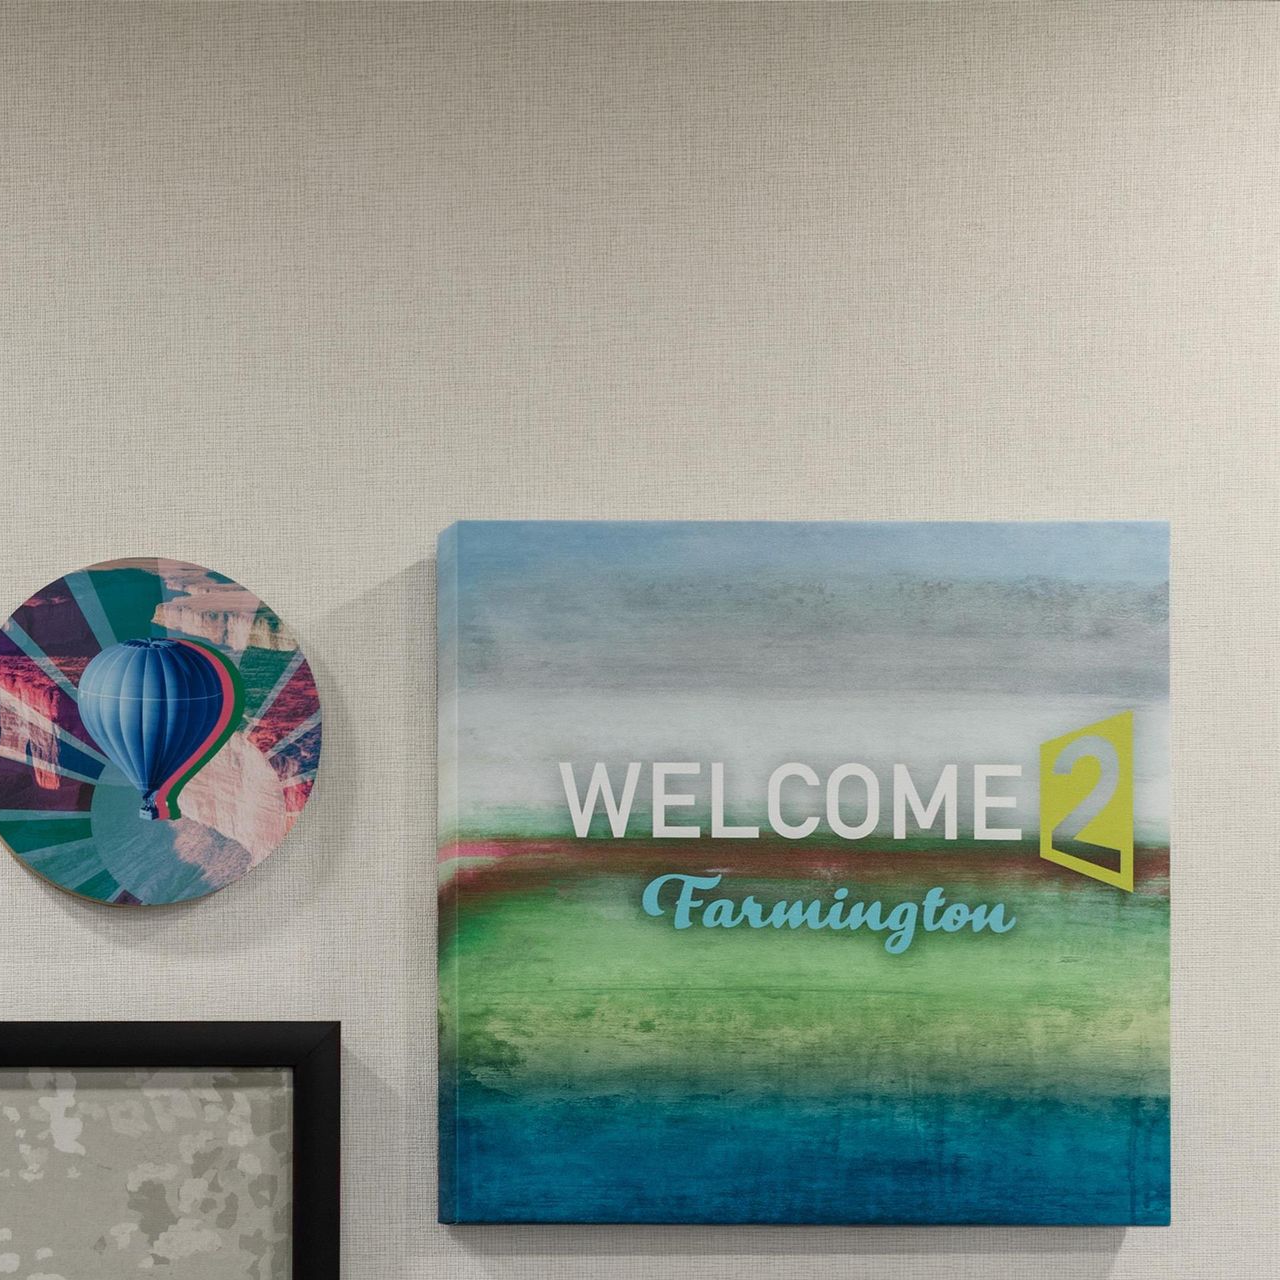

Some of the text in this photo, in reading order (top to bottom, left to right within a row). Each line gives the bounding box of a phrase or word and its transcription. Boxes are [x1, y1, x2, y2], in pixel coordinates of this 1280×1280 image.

[557, 734, 1122, 875] WELCOME 2
[641, 872, 1018, 955] Farmington
